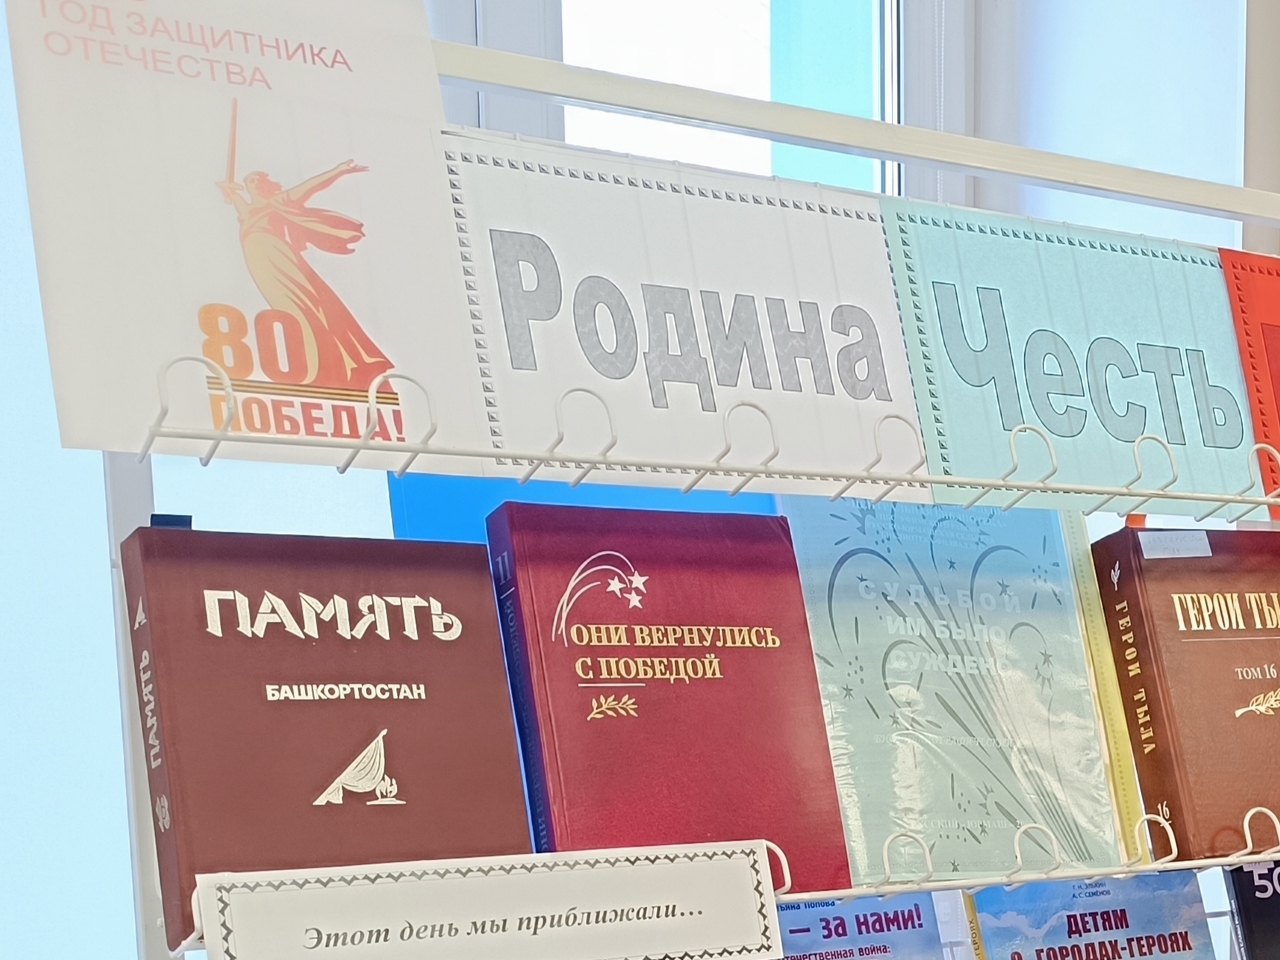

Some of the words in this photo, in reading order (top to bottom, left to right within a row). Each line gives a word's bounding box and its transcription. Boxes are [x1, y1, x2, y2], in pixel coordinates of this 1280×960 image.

[126, 12, 353, 72] ЗАЩИТНИКА
[44, 31, 272, 90] ОТЕЧЕСТВА
[489, 228, 892, 413] Родина
[198, 303, 306, 383] 80
[932, 281, 1245, 450] Честь
[210, 392, 406, 442] ПОБЕДА!
[859, 581, 1021, 613] СУДЬБОЙ
[1172, 593, 1246, 631] ГЕРОИ
[203, 589, 462, 641] ПАМЯТЬ
[886, 616, 926, 637] ИМ
[933, 620, 1007, 642] БЫЛО
[570, 624, 630, 647] ОНИ
[634, 625, 780, 648] ВЕРНУЛИСЬ
[575, 657, 594, 679] С
[597, 654, 723, 684] ПОБЕДОЙ
[890, 650, 1012, 675] СУЖДЕНО
[1115, 599, 1141, 678] ГЕРОИ
[1133, 688, 1154, 755] ТЫЛА
[1235, 667, 1262, 680] ТОМ
[1263, 664, 1277, 680] 16
[266, 684, 426, 700] БАШКОРТОСТАН
[139, 650, 161, 769] ПАМЯТЬ
[1157, 801, 1170, 820] 16
[303, 926, 390, 951] Этот
[399, 921, 460, 944] день
[466, 917, 508, 936] мы
[821, 917, 847, 939] за
[856, 904, 924, 936] нами!
[1066, 908, 1130, 937] ДЕТЯМ
[857, 945, 891, 958] война:
